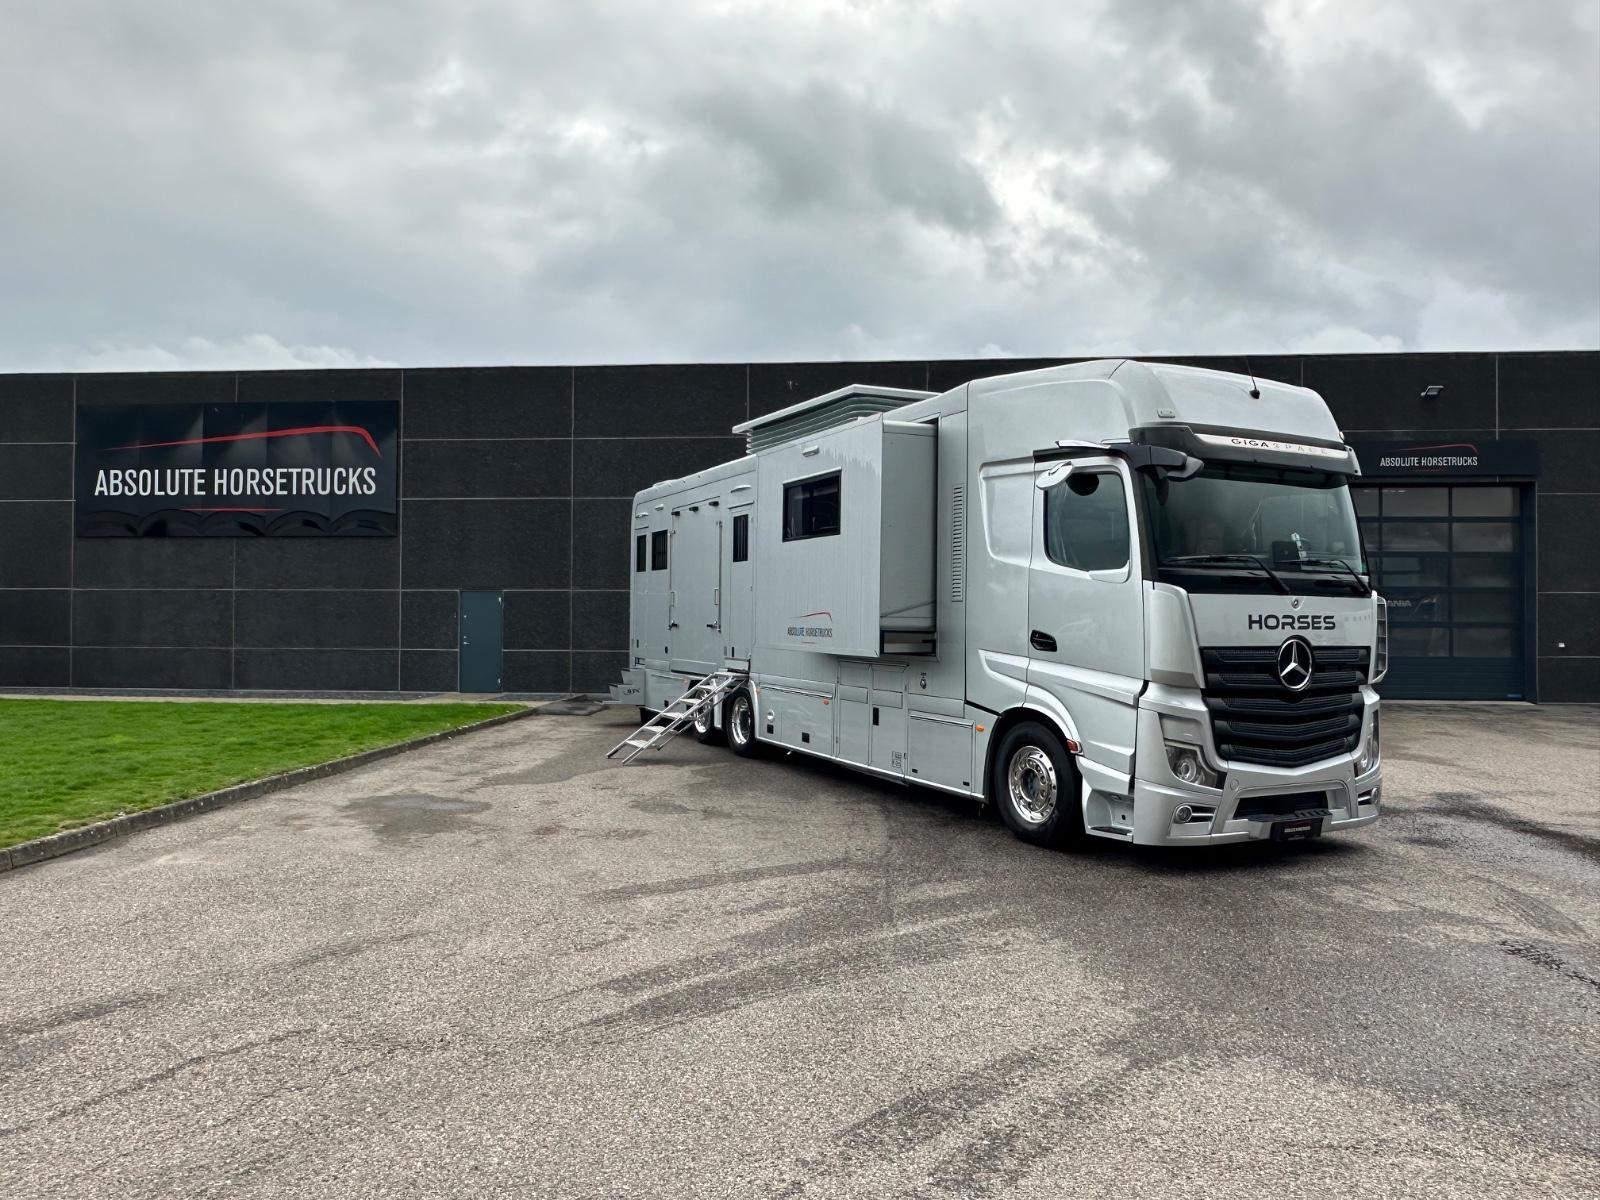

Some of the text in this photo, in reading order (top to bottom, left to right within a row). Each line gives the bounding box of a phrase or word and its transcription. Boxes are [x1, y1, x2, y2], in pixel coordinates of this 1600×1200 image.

[1380, 456, 1478, 467] ABSOLUTE HORSETRUCKS
[94, 467, 376, 496] ABSOLUTE HORSETRUCKS
[1248, 614, 1336, 630] HORSES
